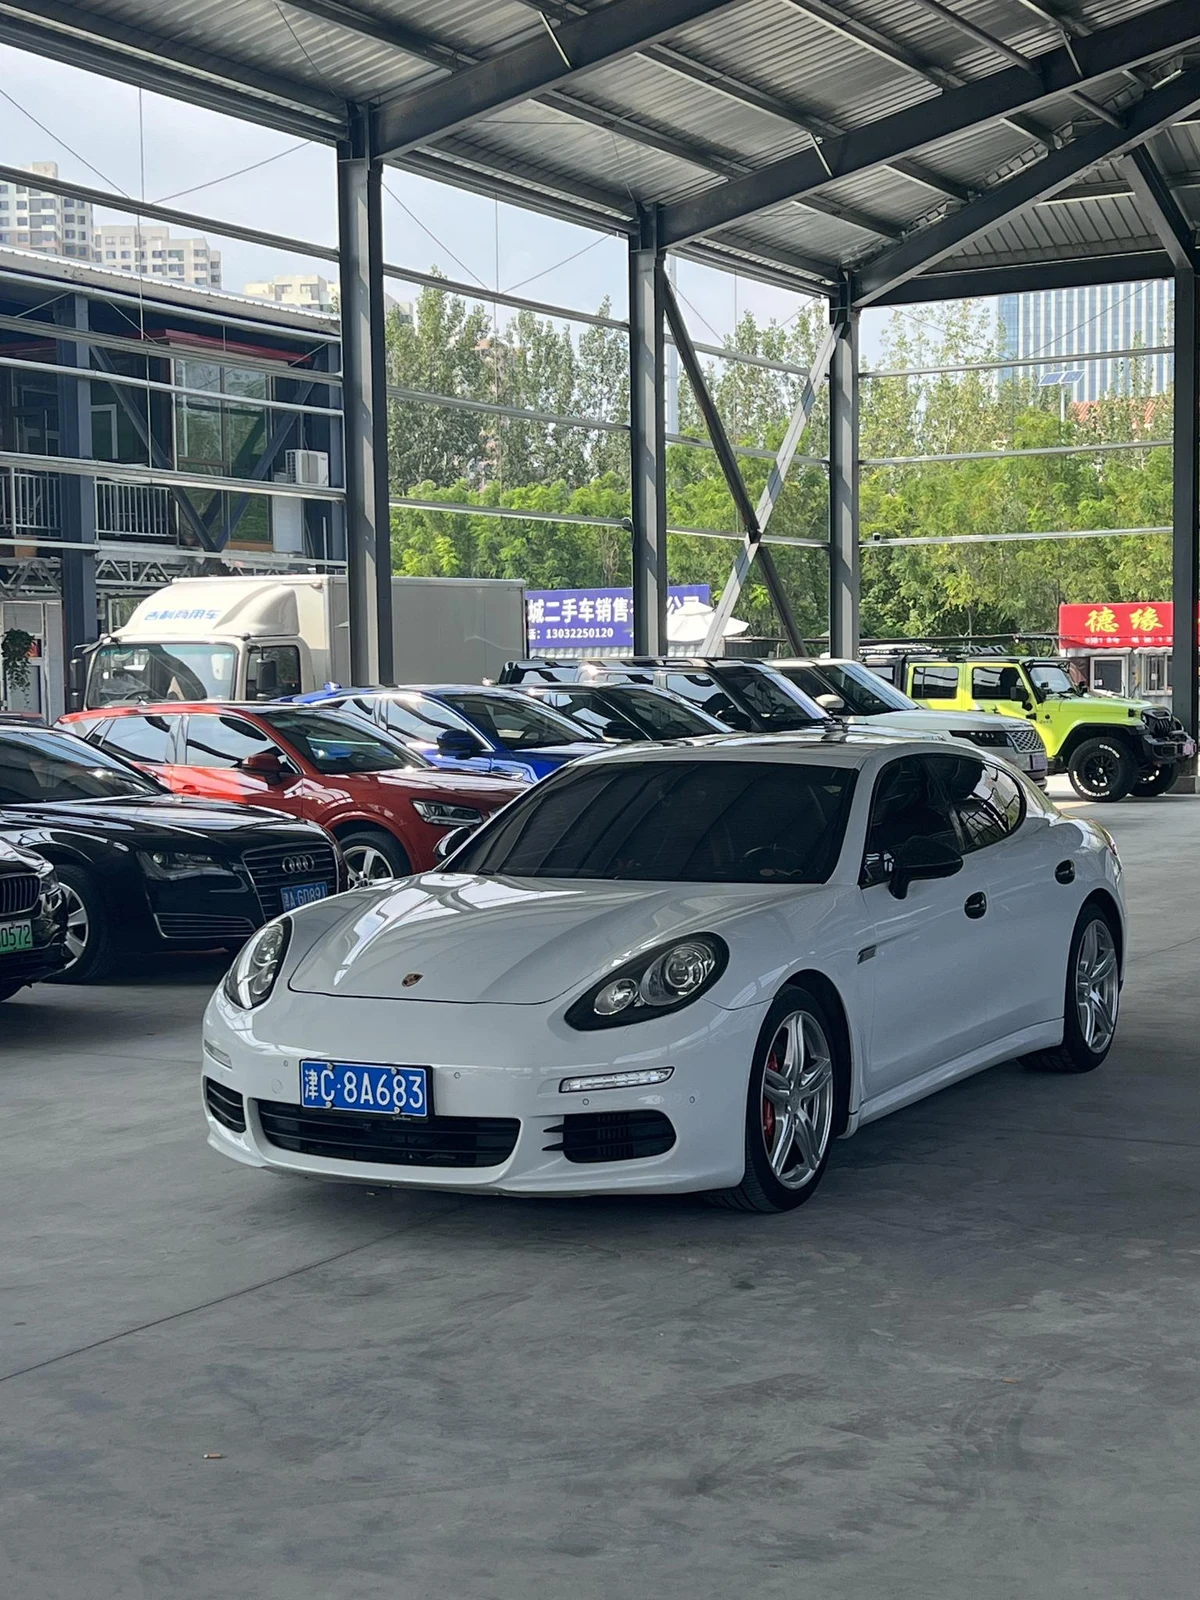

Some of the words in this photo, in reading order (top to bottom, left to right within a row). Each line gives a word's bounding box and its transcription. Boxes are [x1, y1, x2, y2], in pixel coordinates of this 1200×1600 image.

[528, 597, 633, 623] 城二手车销售
[1084, 606, 1163, 633] 德缘
[0, 924, 31, 949] 0572
